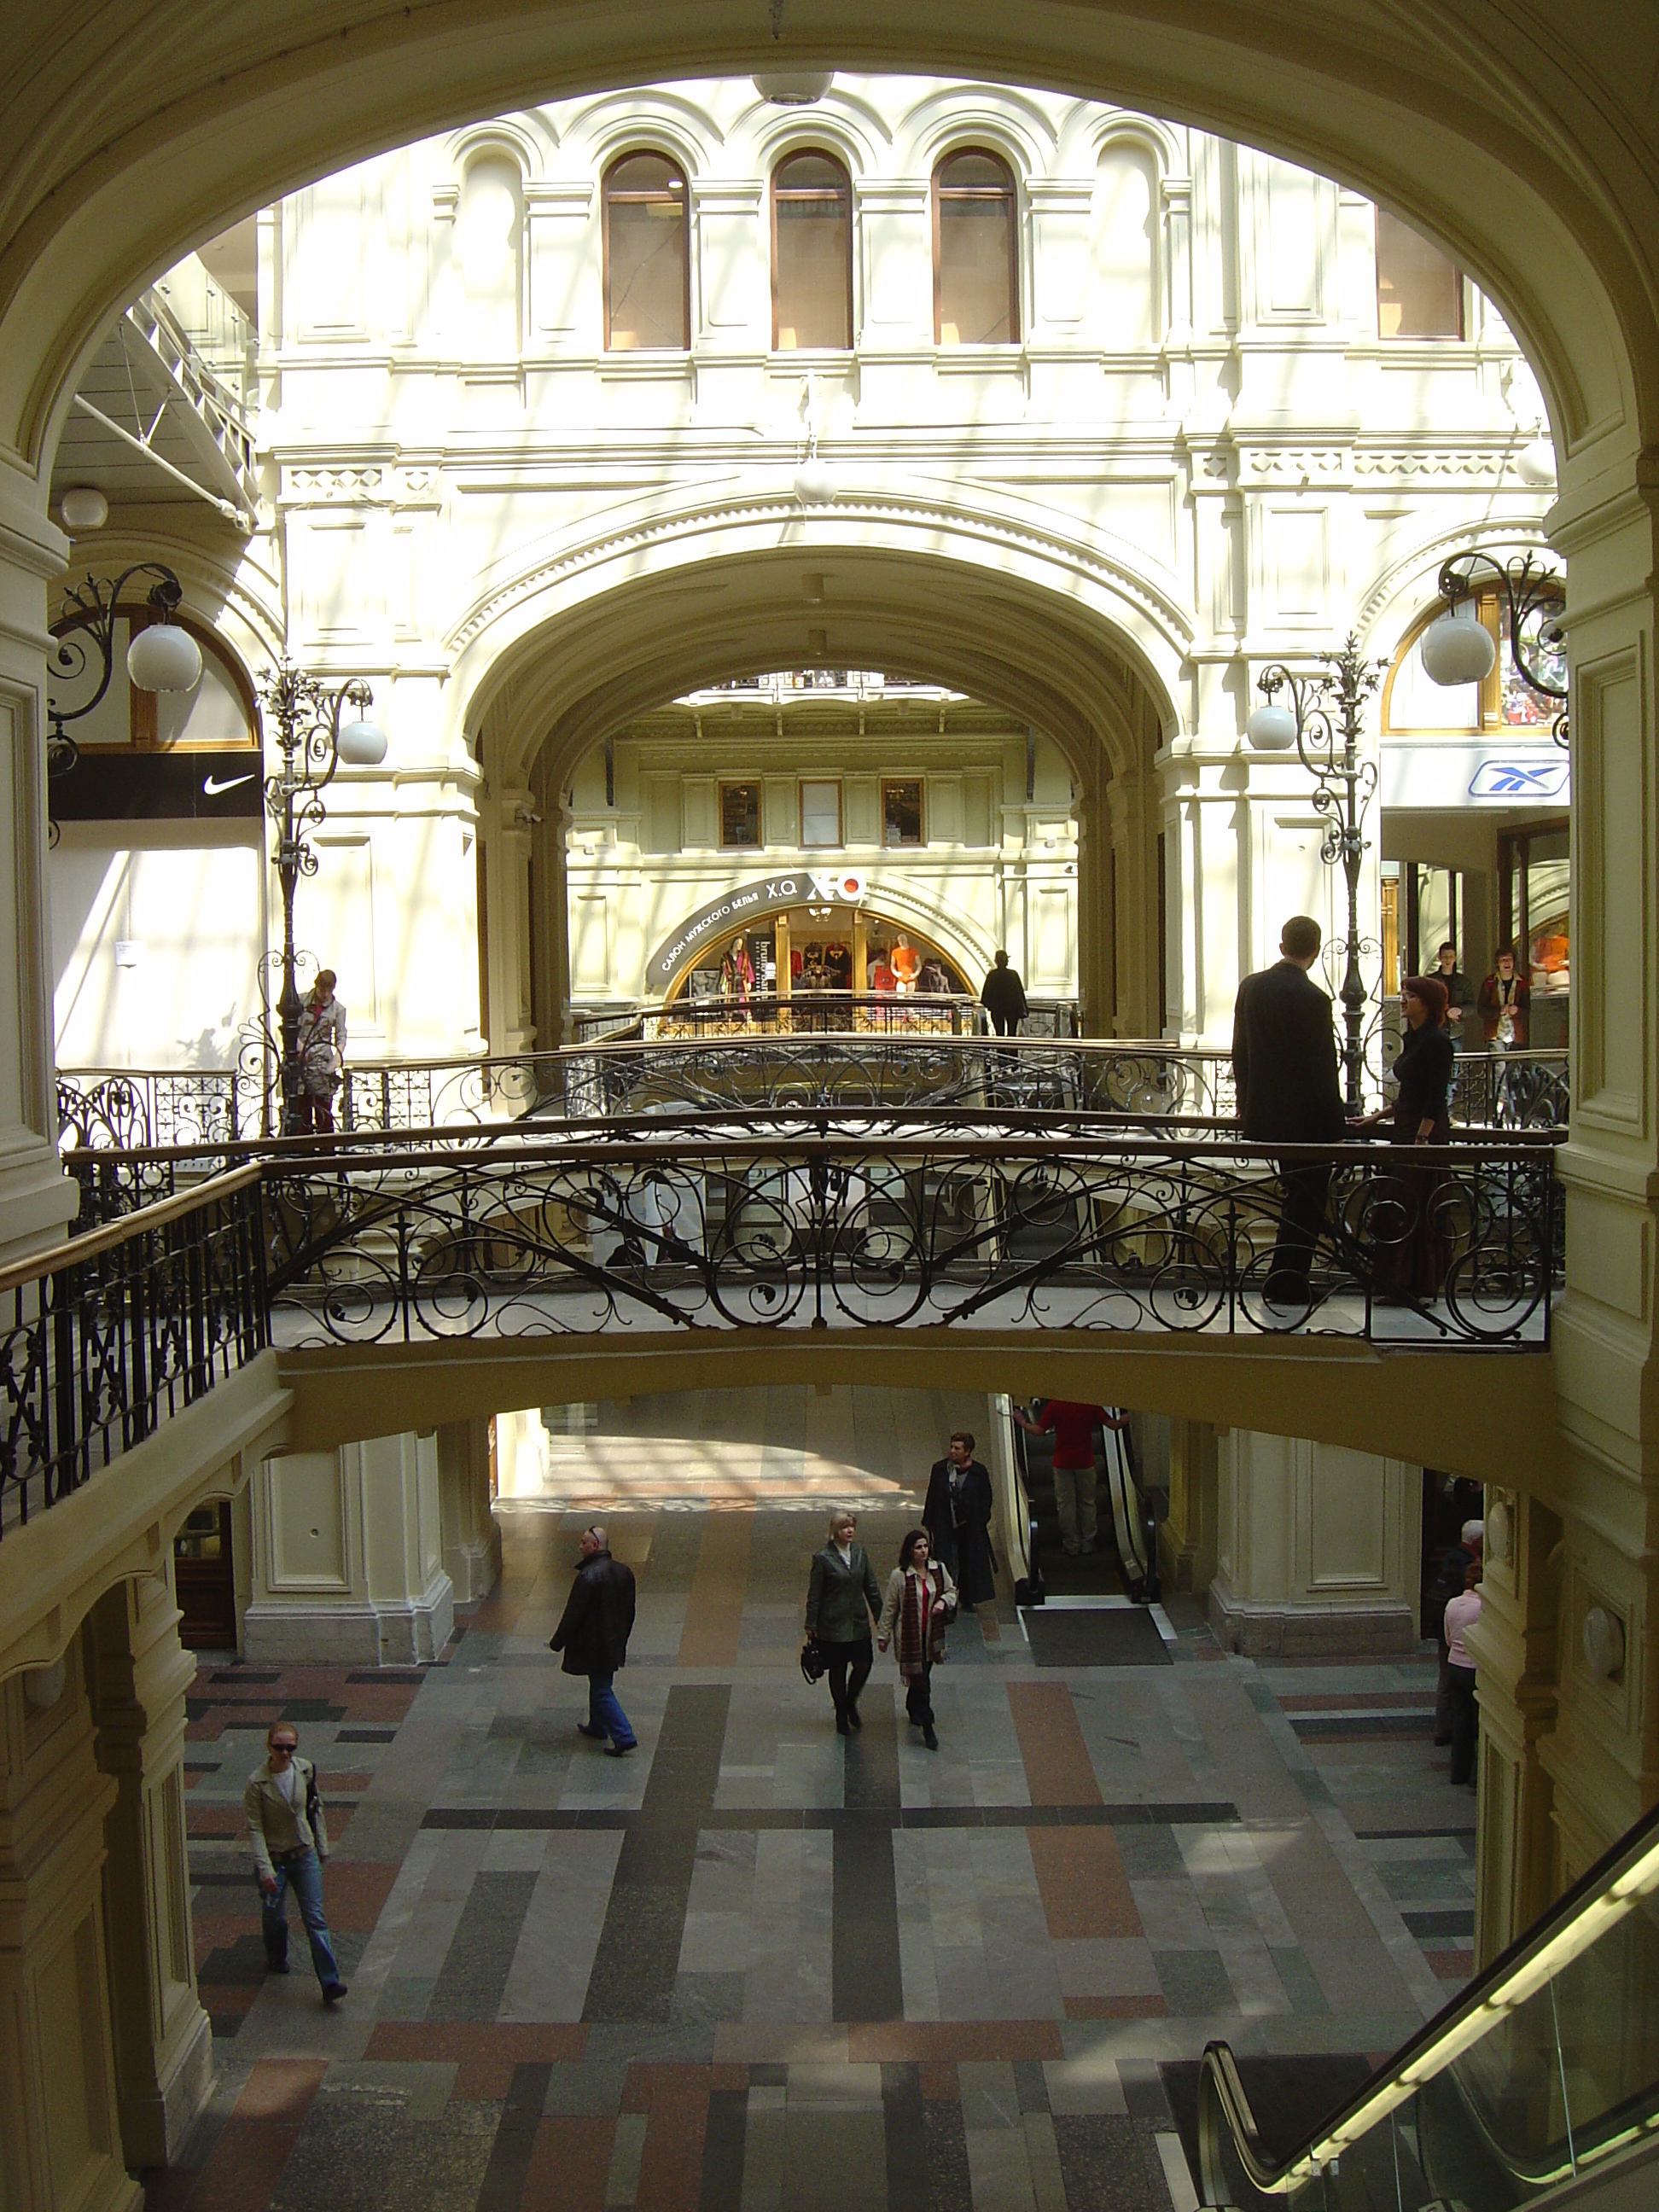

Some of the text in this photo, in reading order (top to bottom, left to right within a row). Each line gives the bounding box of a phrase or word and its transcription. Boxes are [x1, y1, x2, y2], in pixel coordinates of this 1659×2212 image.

[661, 940, 687, 971] САЛОН
[684, 905, 731, 943] МУЖСКОГО
[731, 892, 759, 910] БЕЛЬЯ
